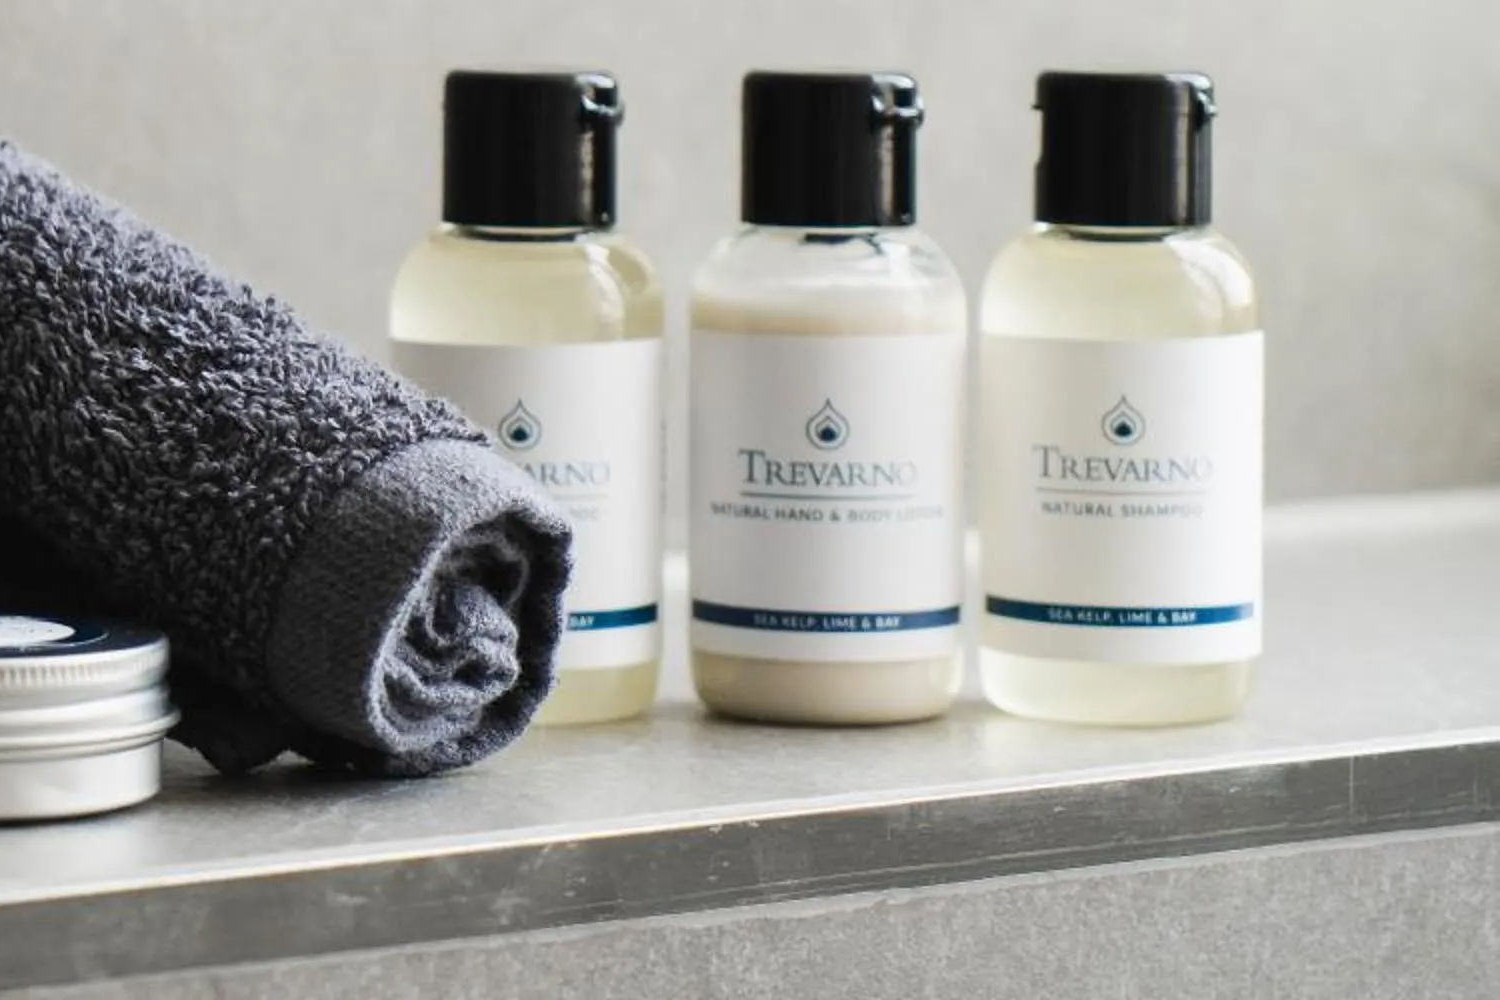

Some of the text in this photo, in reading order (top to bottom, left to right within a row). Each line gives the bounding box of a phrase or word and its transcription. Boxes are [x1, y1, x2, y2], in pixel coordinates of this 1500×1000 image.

[521, 461, 611, 486] ARNO
[738, 449, 918, 487] TREVARNO
[1032, 445, 1212, 483] TREVARNO
[711, 502, 770, 520] NATURAL
[775, 506, 824, 522] HAND
[1041, 500, 1114, 518] NATURAL
[753, 613, 778, 626] SEA
[823, 616, 856, 629] LIME
[875, 616, 900, 628] BAY
[1048, 608, 1073, 620] SEA
[1119, 612, 1152, 624] LIME
[1171, 611, 1197, 623] BAY
